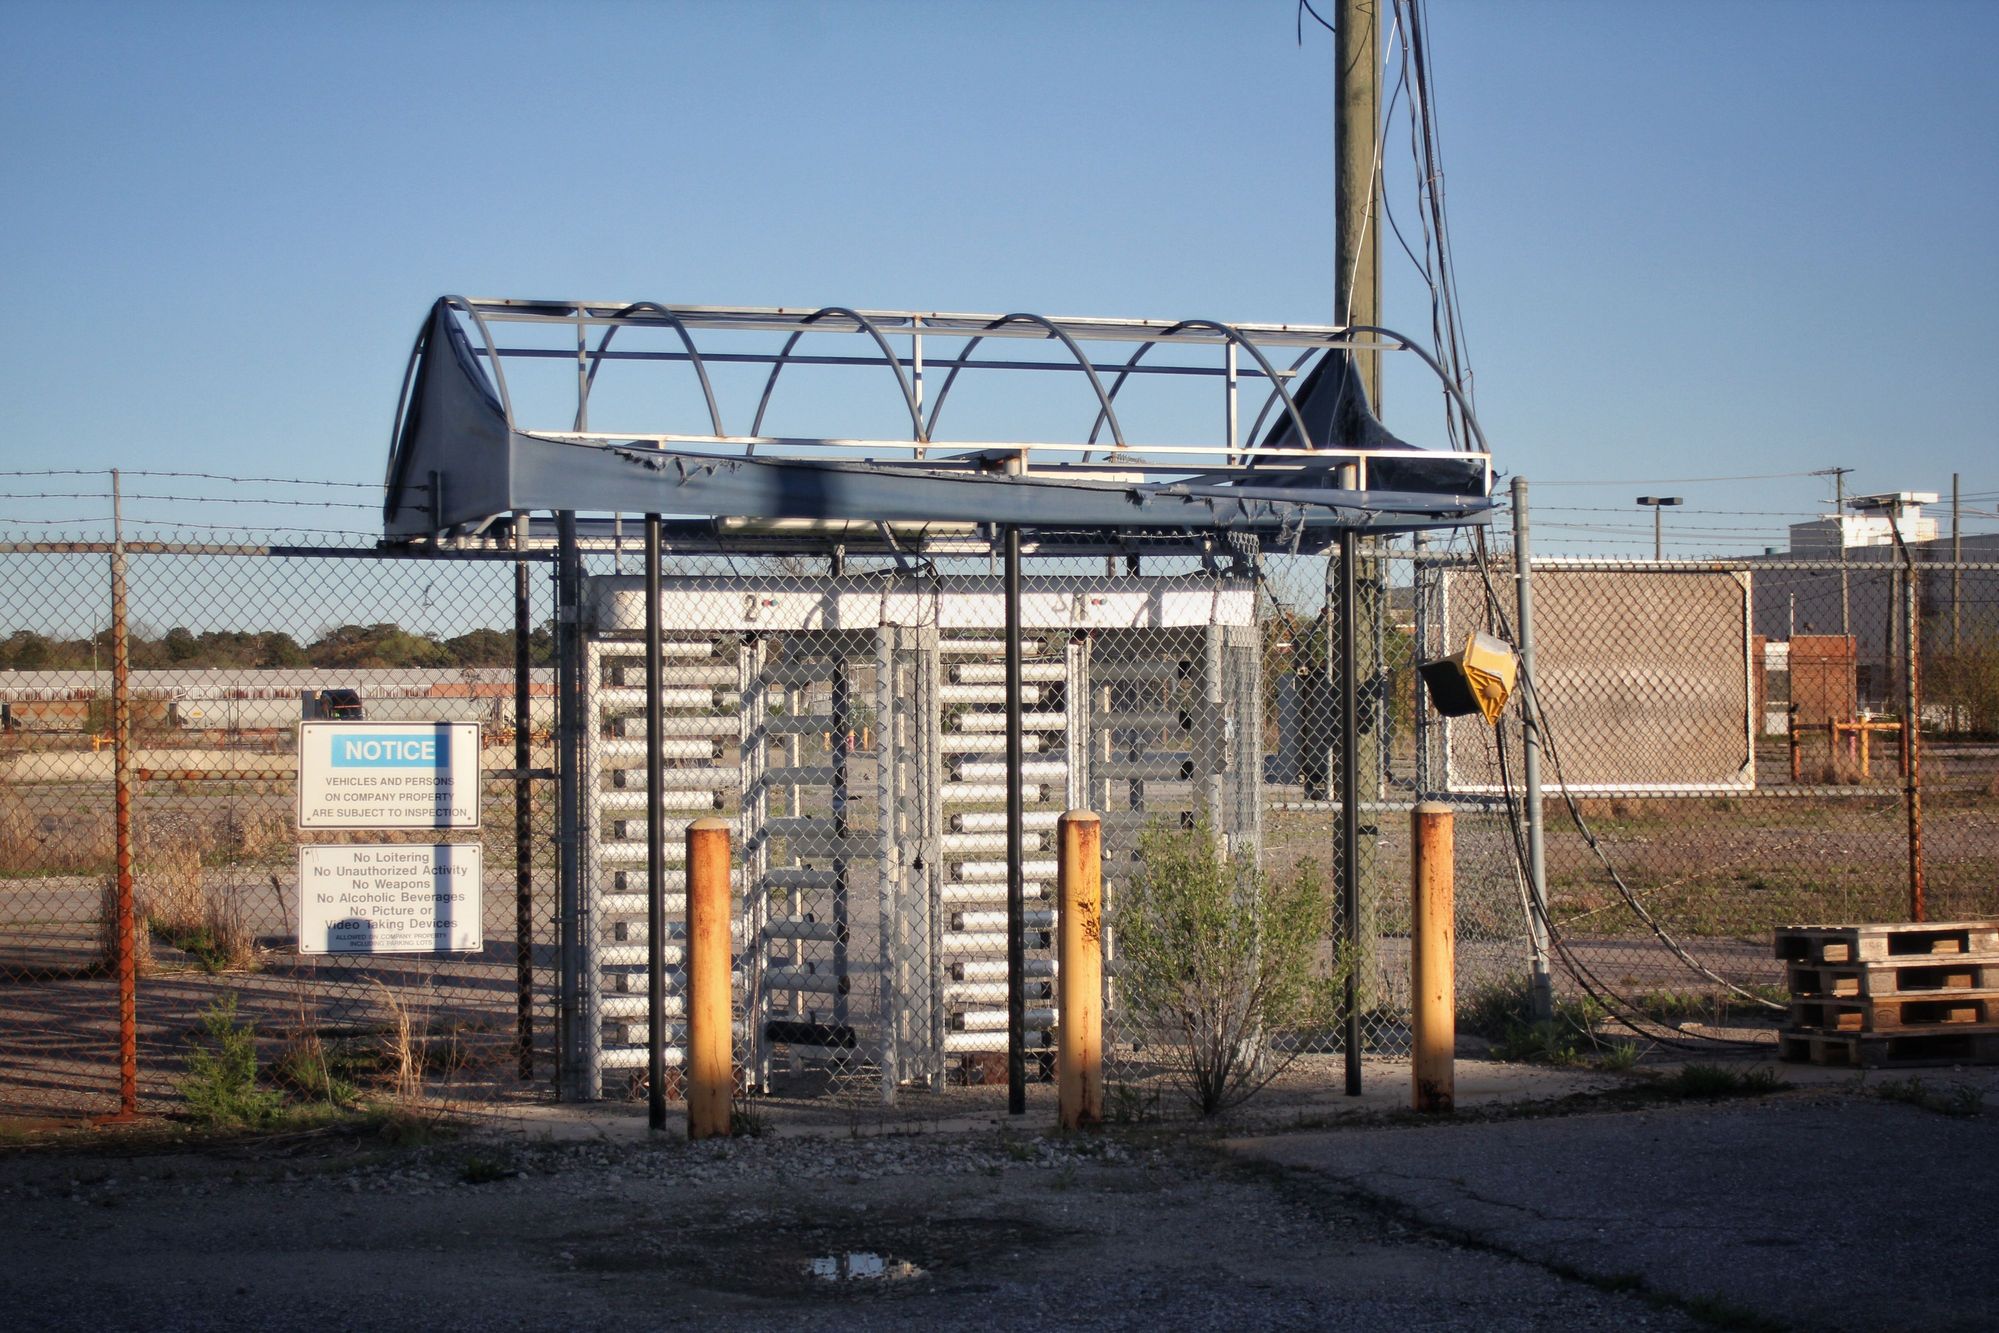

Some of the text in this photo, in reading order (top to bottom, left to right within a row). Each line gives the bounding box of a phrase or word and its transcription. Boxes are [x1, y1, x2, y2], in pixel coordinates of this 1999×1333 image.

[744, 594, 757, 622] 2
[346, 741, 436, 760] NOTICE
[326, 777, 454, 786] VEHICLES AND PERSONS
[325, 793, 454, 801] ON COMPANY PROPERTY
[312, 808, 467, 817] ARE SUBJECT TO INSPECTION
[354, 852, 429, 864] No Loitering
[314, 866, 467, 877] No Unauthorized Activity
[352, 880, 430, 891] No Weapons
[317, 892, 465, 904] No Alcoholic Beverages
[350, 906, 367, 916] No
[372, 906, 414, 916] Picture
[325, 919, 458, 930] Video Taking Devices
